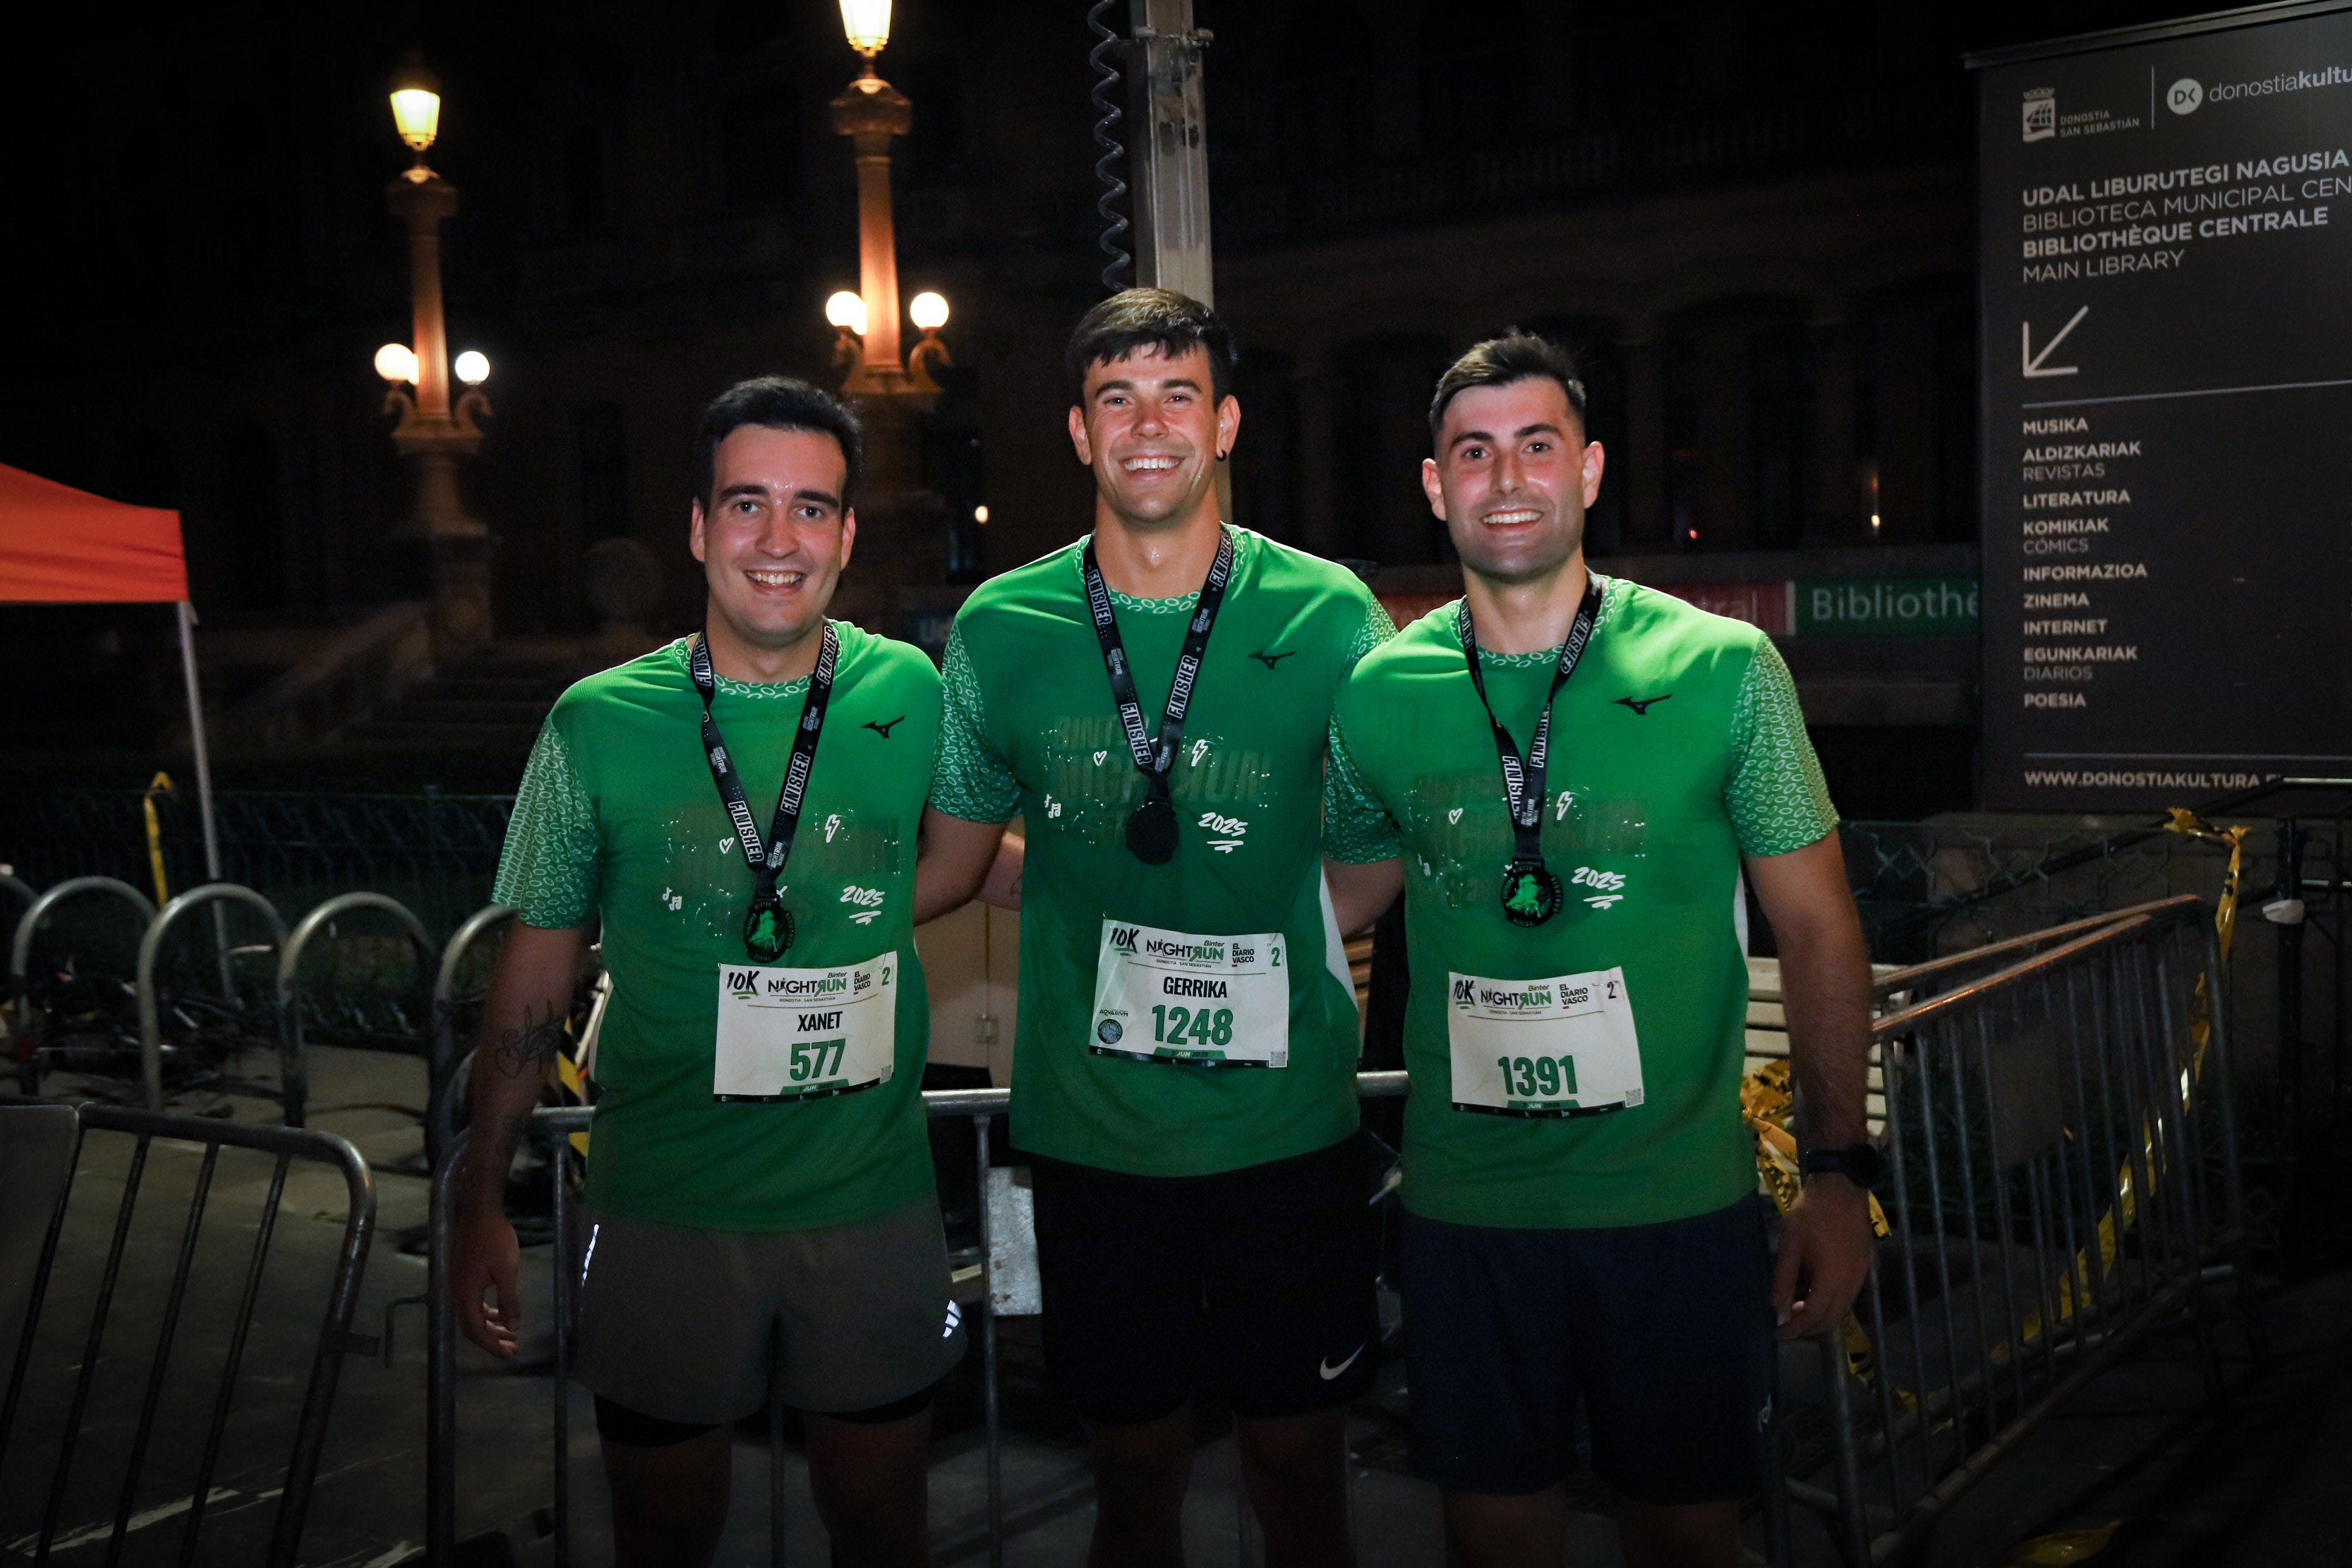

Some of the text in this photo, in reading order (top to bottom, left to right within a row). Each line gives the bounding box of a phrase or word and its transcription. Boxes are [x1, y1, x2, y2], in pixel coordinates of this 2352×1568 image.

[2060, 109, 2110, 126] DONOSTIA
[2060, 117, 2140, 138] SAN SEBASTIÁN
[2023, 149, 2350, 207] UDAL LIBURUTEGI NAGUSIA
[2023, 200, 2157, 233] BIBLIOTECA
[2164, 185, 2293, 217] MUNICIPAL
[2023, 207, 2329, 258] BIBLIOTHÈQUE CENTRALE
[2023, 248, 2185, 283] MAIN LIBRARY
[2022, 417, 2089, 435] MUSIKA
[2022, 441, 2142, 463] ALDIZKARIAK
[2022, 462, 2106, 482] REVISTAS
[2022, 489, 2131, 509] LITERATURA
[2022, 518, 2110, 536] KOMIKIAK
[2023, 564, 2148, 582] INFORMAZIOA
[1087, 568, 1113, 625] FINISHER
[2023, 593, 2090, 609] ZINEMA
[2023, 619, 2108, 636] INTERNET
[1560, 613, 1591, 674] FINISHER
[2024, 646, 2138, 663] EGUNKARIAK
[816, 626, 837, 685] FINISHER
[2024, 666, 2093, 682] DIARIOS
[1167, 654, 1198, 719] FINISHER
[2024, 692, 2087, 708] POESIA
[1121, 702, 1152, 764] FINISHER
[780, 752, 810, 814] FINISHER
[728, 800, 764, 862] FINISHER
[1198, 812, 1248, 836] 2025
[1572, 867, 1626, 891] 2025
[840, 885, 886, 907] 2025
[1110, 928, 1140, 953] 10K
[1232, 948, 1254, 957] DIARIO
[1271, 947, 1280, 967] 2
[727, 970, 760, 996] 10K
[854, 973, 871, 984] DIARIO
[855, 981, 871, 991] VASCO
[882, 967, 891, 986] 2
[1164, 976, 1227, 998] GERRIKA
[1454, 979, 1475, 1005] 10K
[1560, 987, 1588, 998] DIARIO
[1562, 996, 1588, 1005] VASCO
[1607, 982, 1617, 999] 2
[797, 1011, 843, 1032] XANET
[1152, 1005, 1234, 1046] 1248
[790, 1038, 846, 1081] 577
[1497, 1055, 1578, 1096] 1391
